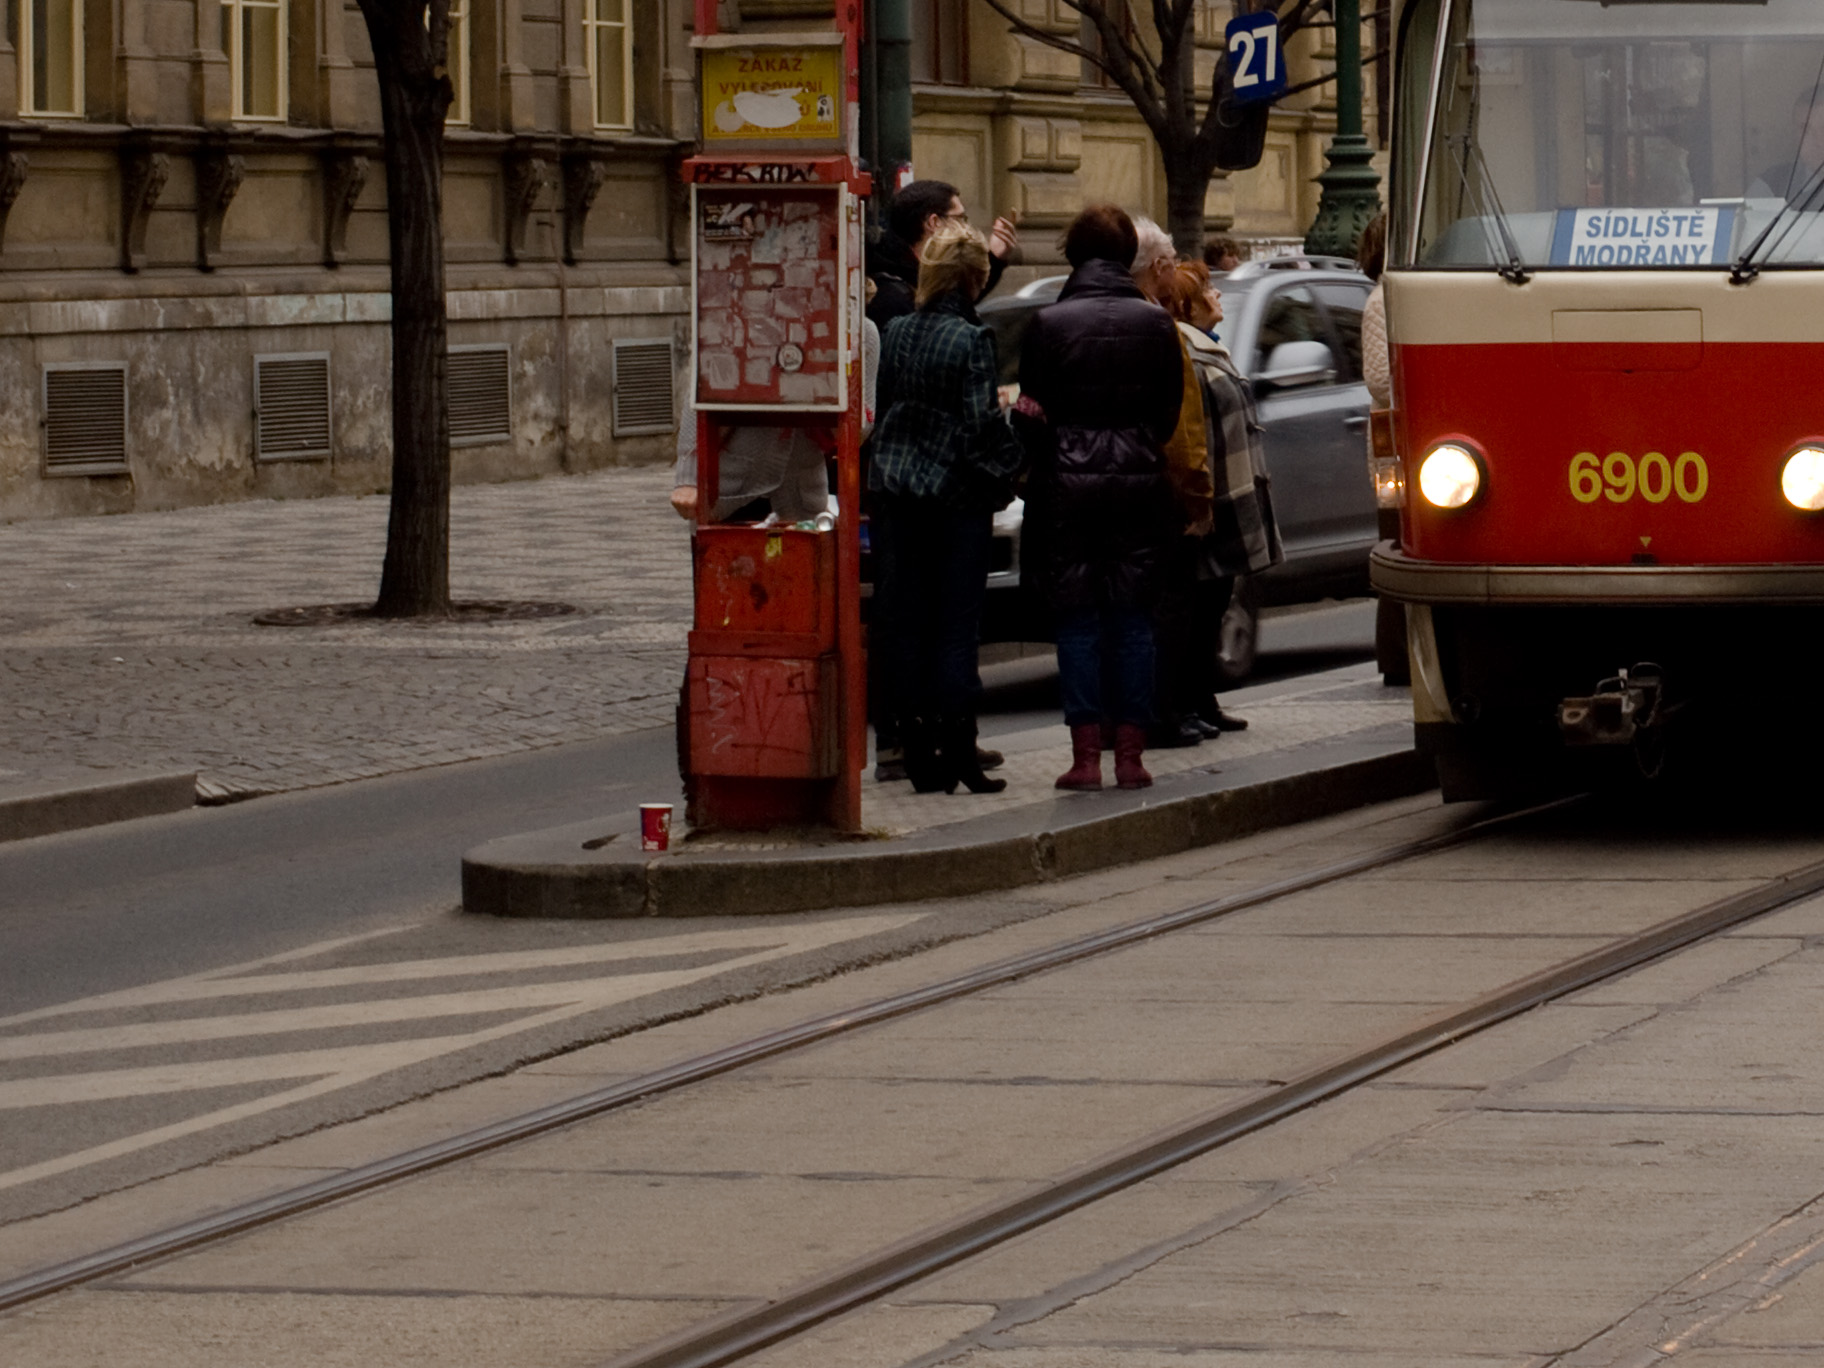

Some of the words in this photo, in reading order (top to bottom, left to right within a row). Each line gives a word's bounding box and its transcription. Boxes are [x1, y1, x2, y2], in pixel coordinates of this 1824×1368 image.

[738, 55, 803, 73] ZÁKAZ
[1229, 24, 1277, 89] 27
[1586, 210, 1705, 238] SÍDLIŠTĚ
[1575, 239, 1707, 265] MODŘANY
[1568, 451, 1709, 504] 6900
